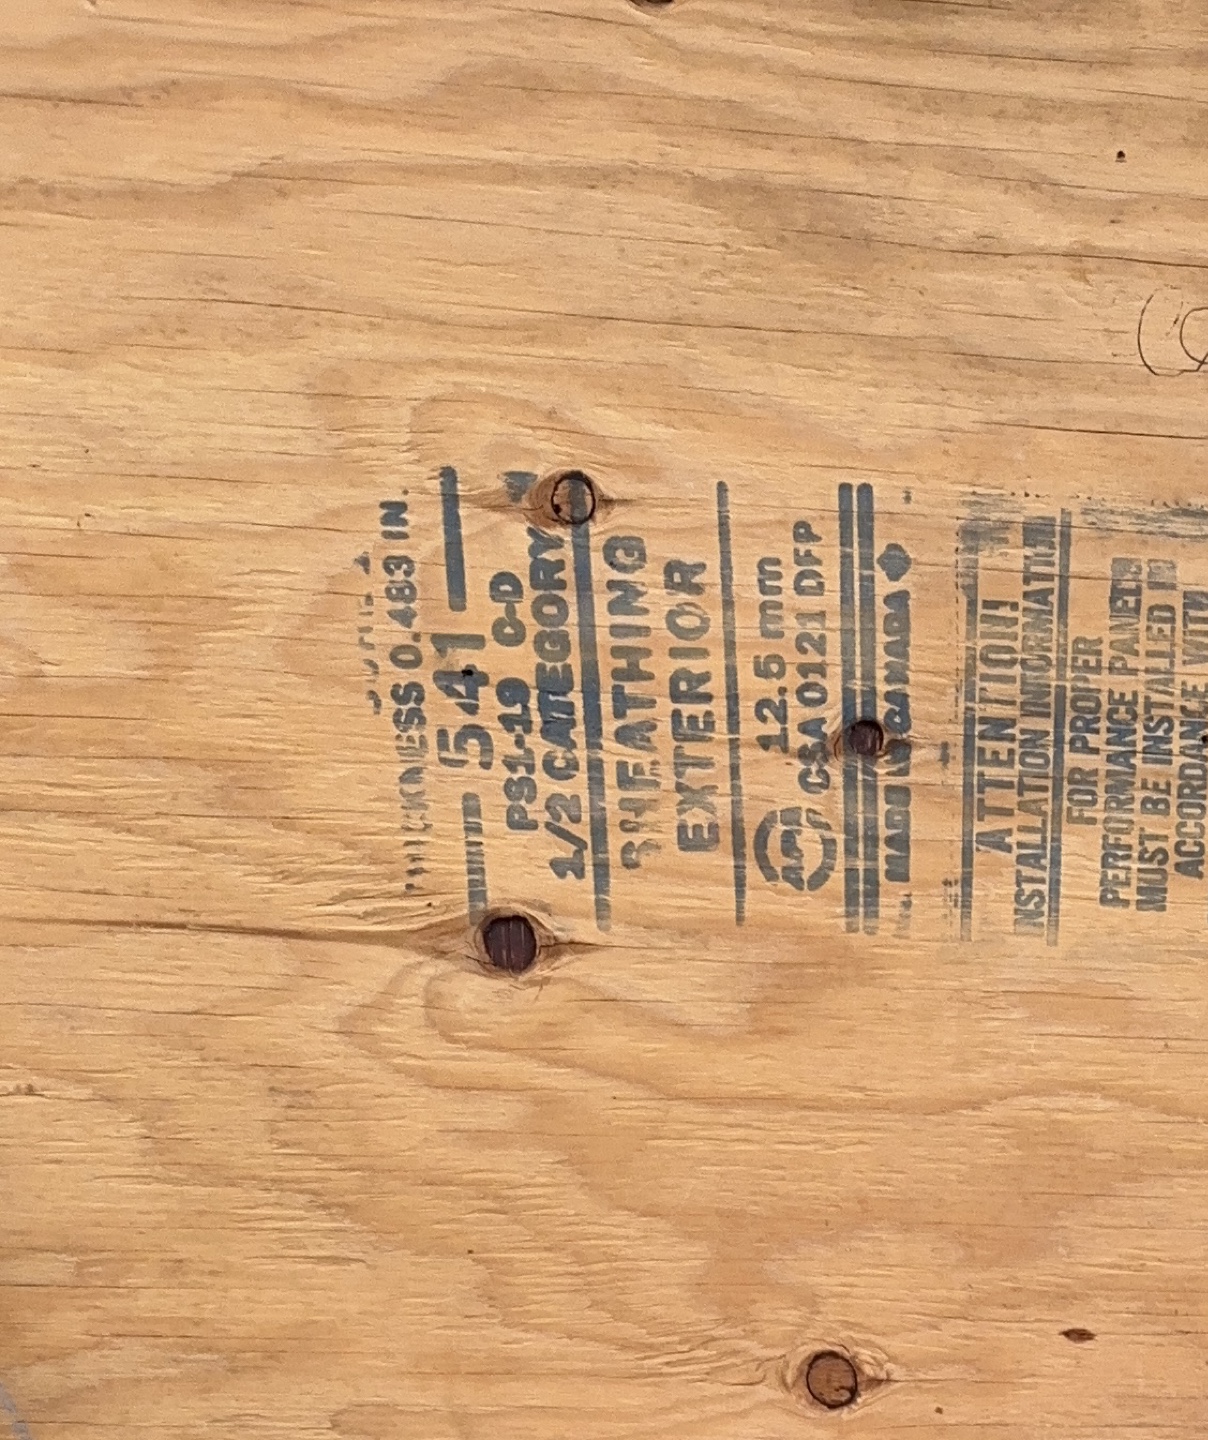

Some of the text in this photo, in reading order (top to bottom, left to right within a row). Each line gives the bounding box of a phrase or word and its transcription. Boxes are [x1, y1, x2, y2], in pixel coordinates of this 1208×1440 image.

[382, 554, 423, 669] 0.483
[792, 520, 826, 597] DFP
[430, 633, 493, 770] 541
[526, 527, 587, 880] 1/2 CATEGORY
[602, 535, 662, 870] SHEATHING
[663, 559, 720, 853] EXTERIOR
[753, 556, 789, 754] 12.5 mm
[975, 599, 1020, 854] ATTENTION!
[1066, 636, 1106, 826] FOR PROPER
[1142, 604, 1176, 766] INSTALLED
[495, 678, 539, 831] PS1-19
[797, 716, 830, 795] CSA
[1099, 689, 1138, 909] PERFORMANCE
[1140, 771, 1172, 817] BE
[1136, 827, 1169, 913] MUST
